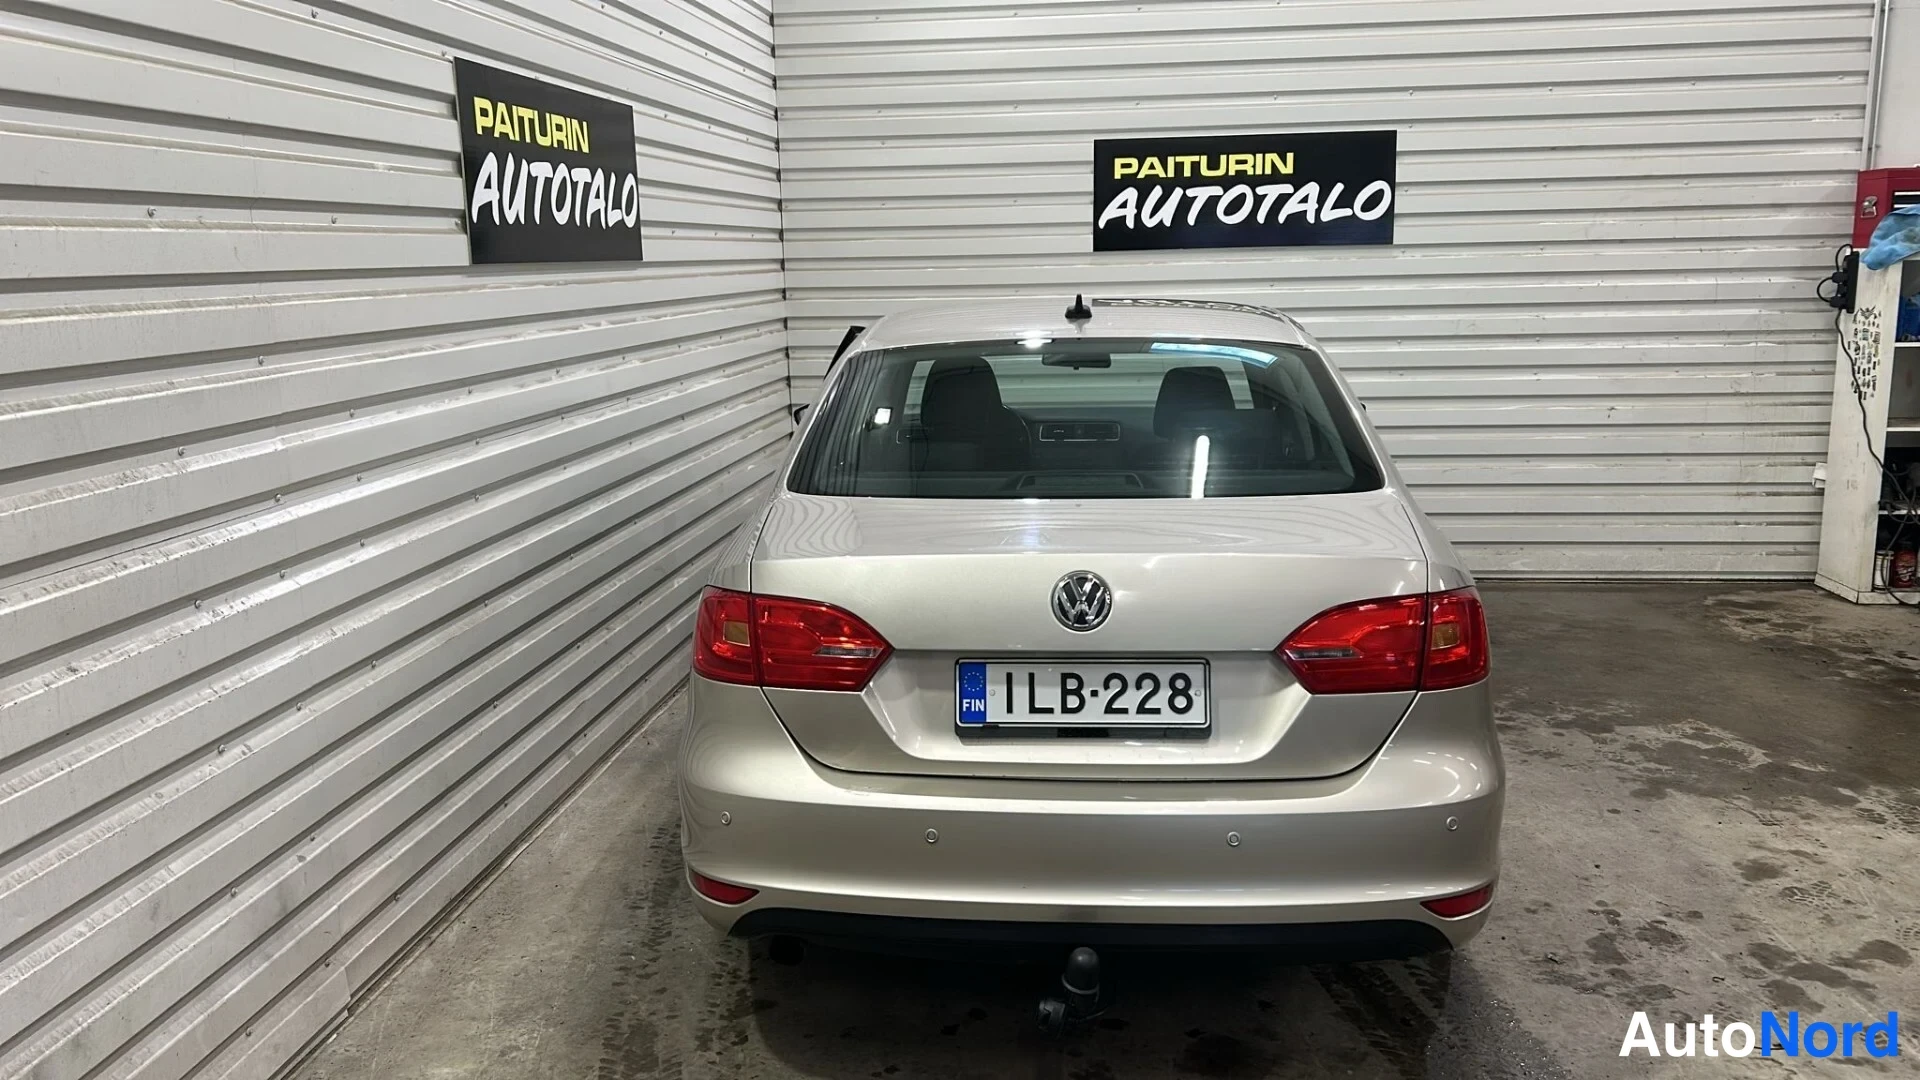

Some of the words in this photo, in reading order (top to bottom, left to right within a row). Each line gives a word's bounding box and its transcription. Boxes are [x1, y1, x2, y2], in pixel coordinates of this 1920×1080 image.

[473, 96, 589, 153] PAITURIN
[1114, 152, 1294, 179] PAITURIN
[471, 152, 638, 229] AUTOTALO
[1098, 180, 1392, 229] AUTOTALO
[1052, 571, 1111, 631] VW
[962, 699, 985, 713] FIN
[1006, 672, 1193, 715] ILB-228
